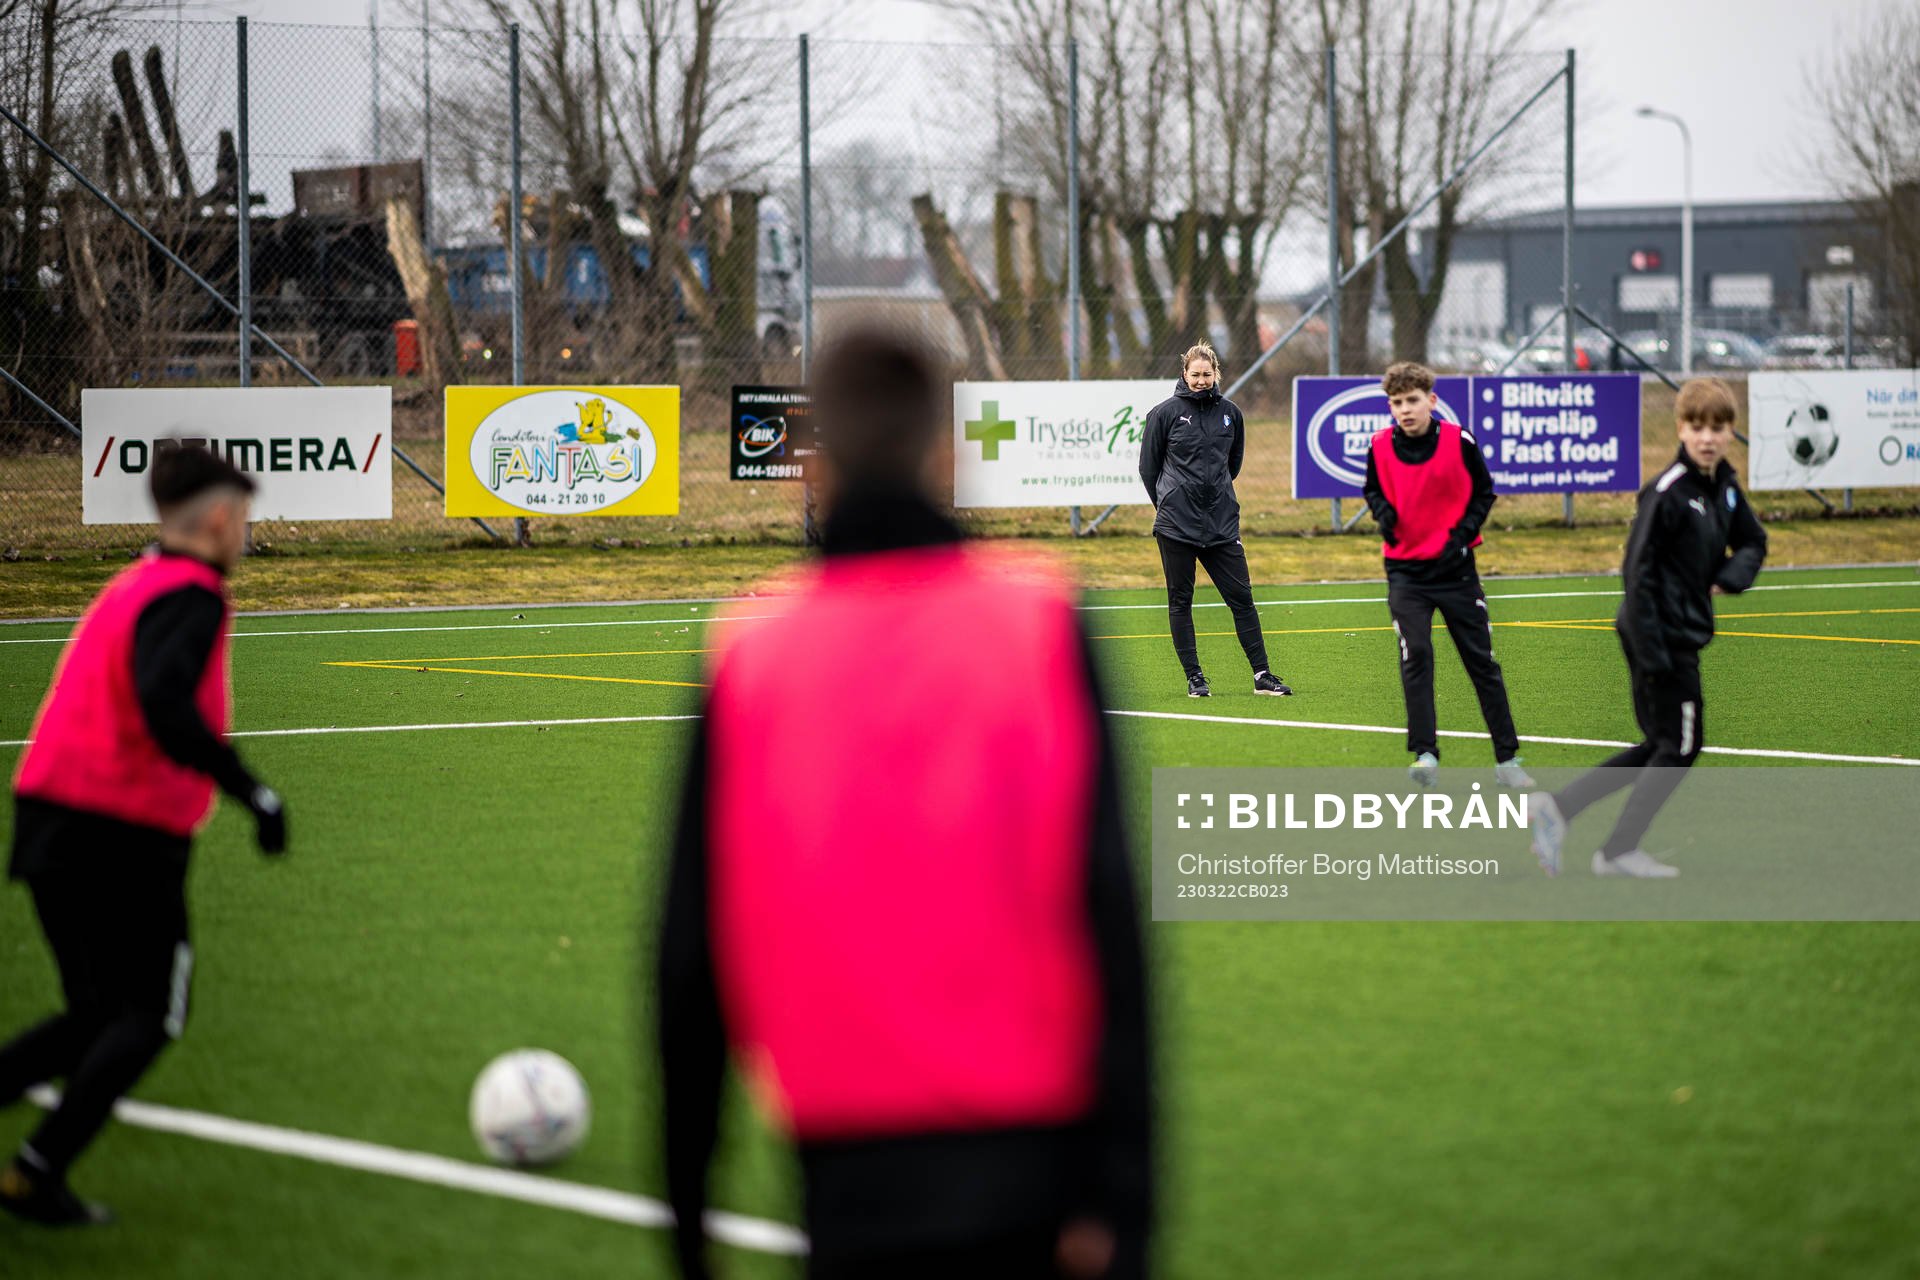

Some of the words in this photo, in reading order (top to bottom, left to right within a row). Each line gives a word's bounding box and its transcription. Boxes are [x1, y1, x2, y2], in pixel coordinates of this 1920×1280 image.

[1502, 382, 1595, 408] Biltvätt
[751, 428, 776, 442] BIK
[1335, 414, 1393, 433] BUTIK
[1502, 410, 1598, 440] Hyrsläp
[1501, 438, 1555, 463] Fast
[1561, 436, 1618, 463] food
[490, 435, 642, 491] FANTASI
[526, 494, 547, 505] 044
[558, 494, 571, 505] 21
[575, 494, 588, 505] 20
[593, 494, 605, 505] 10
